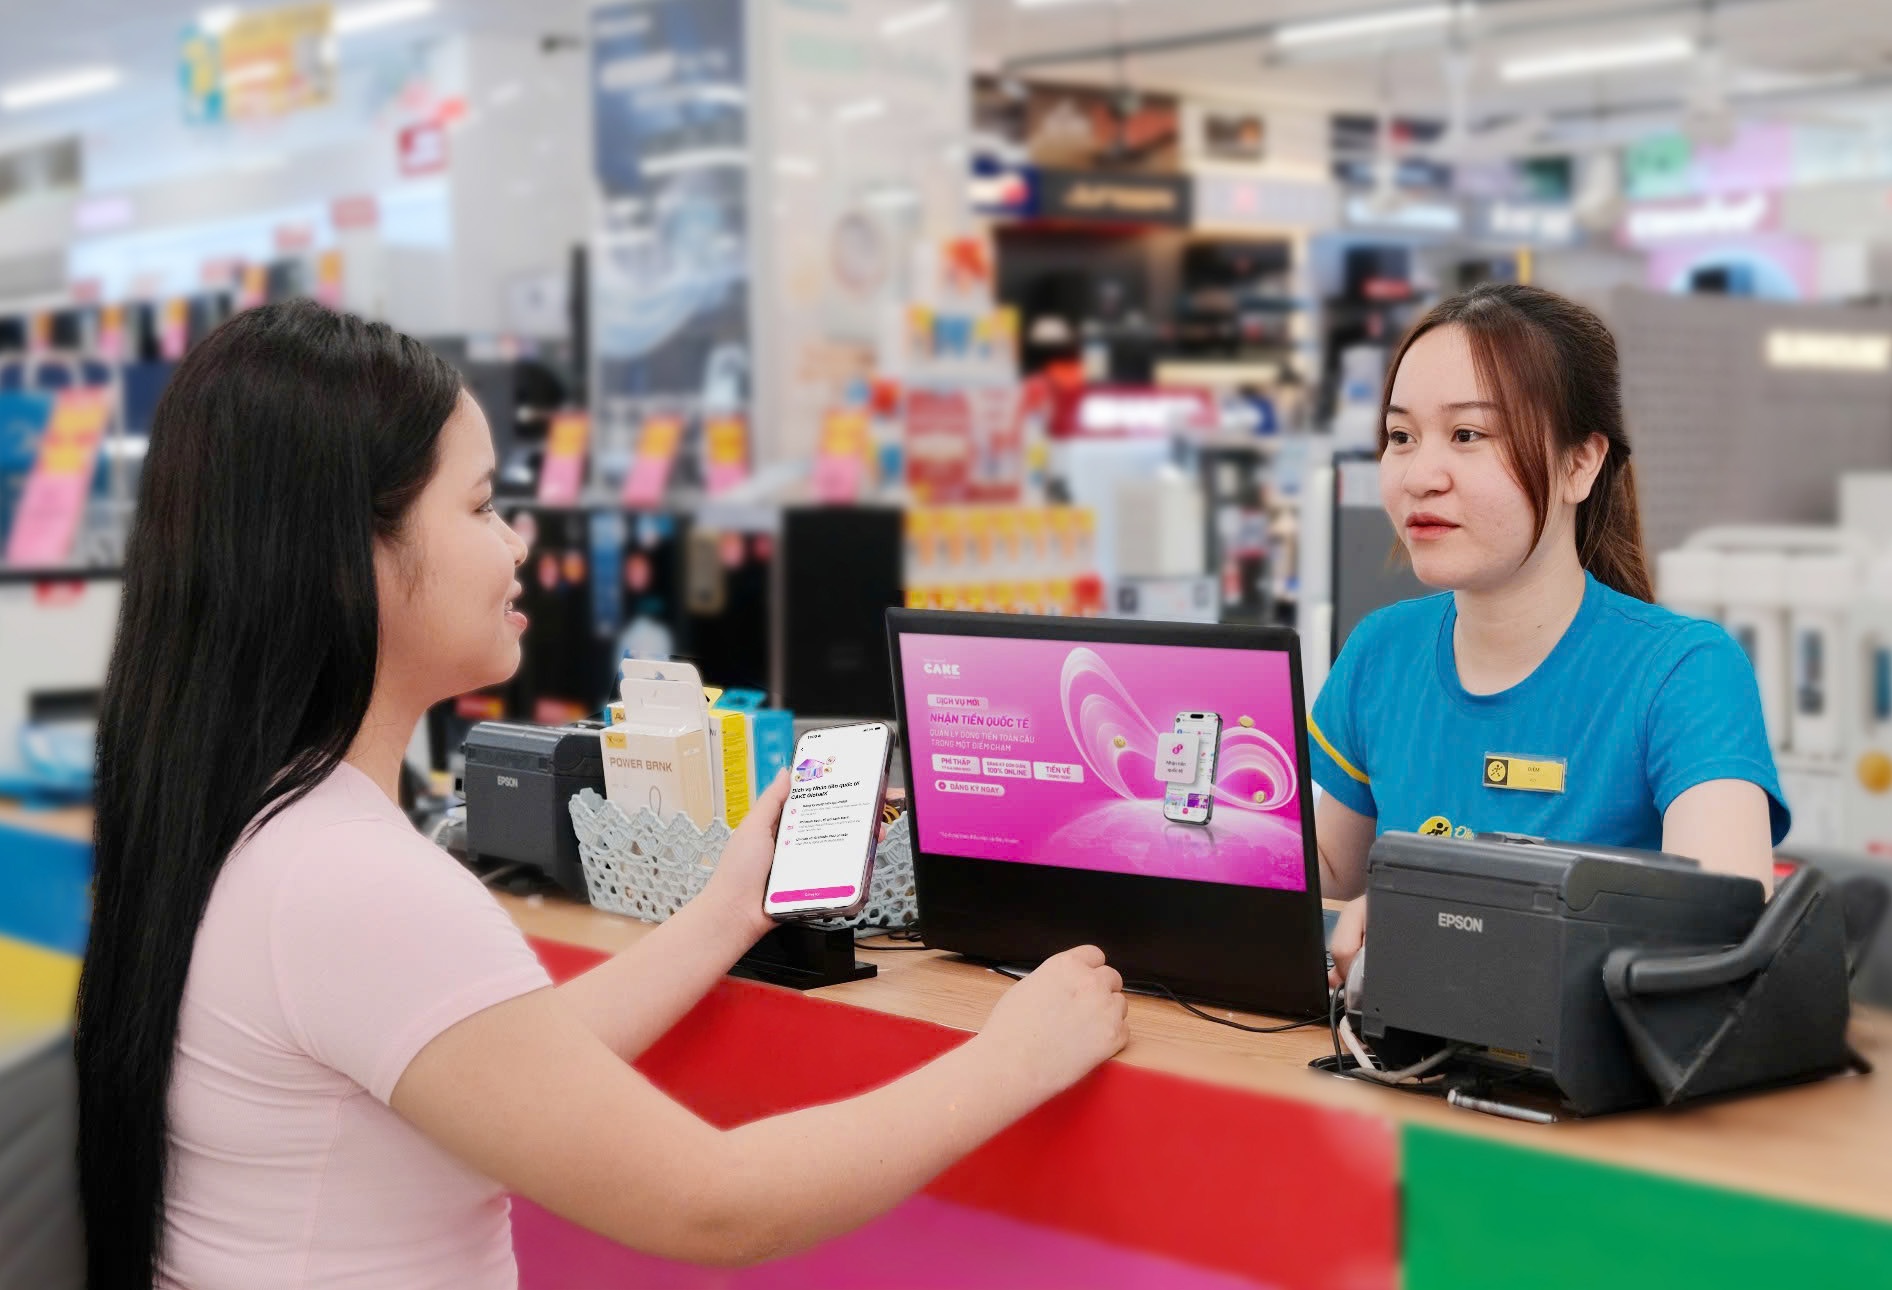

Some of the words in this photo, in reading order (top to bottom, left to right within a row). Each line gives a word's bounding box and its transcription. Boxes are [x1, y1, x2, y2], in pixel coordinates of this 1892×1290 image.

[923, 663, 960, 676] CAKE
[930, 711, 959, 726] NHẬN
[986, 714, 1014, 728] QUỐC
[609, 756, 643, 769] POWER
[645, 760, 673, 772] BANK
[987, 766, 1004, 775] 100%
[1004, 768, 1027, 777] ONLINE
[497, 775, 519, 788] EPSON
[1438, 911, 1483, 933] EPSON
